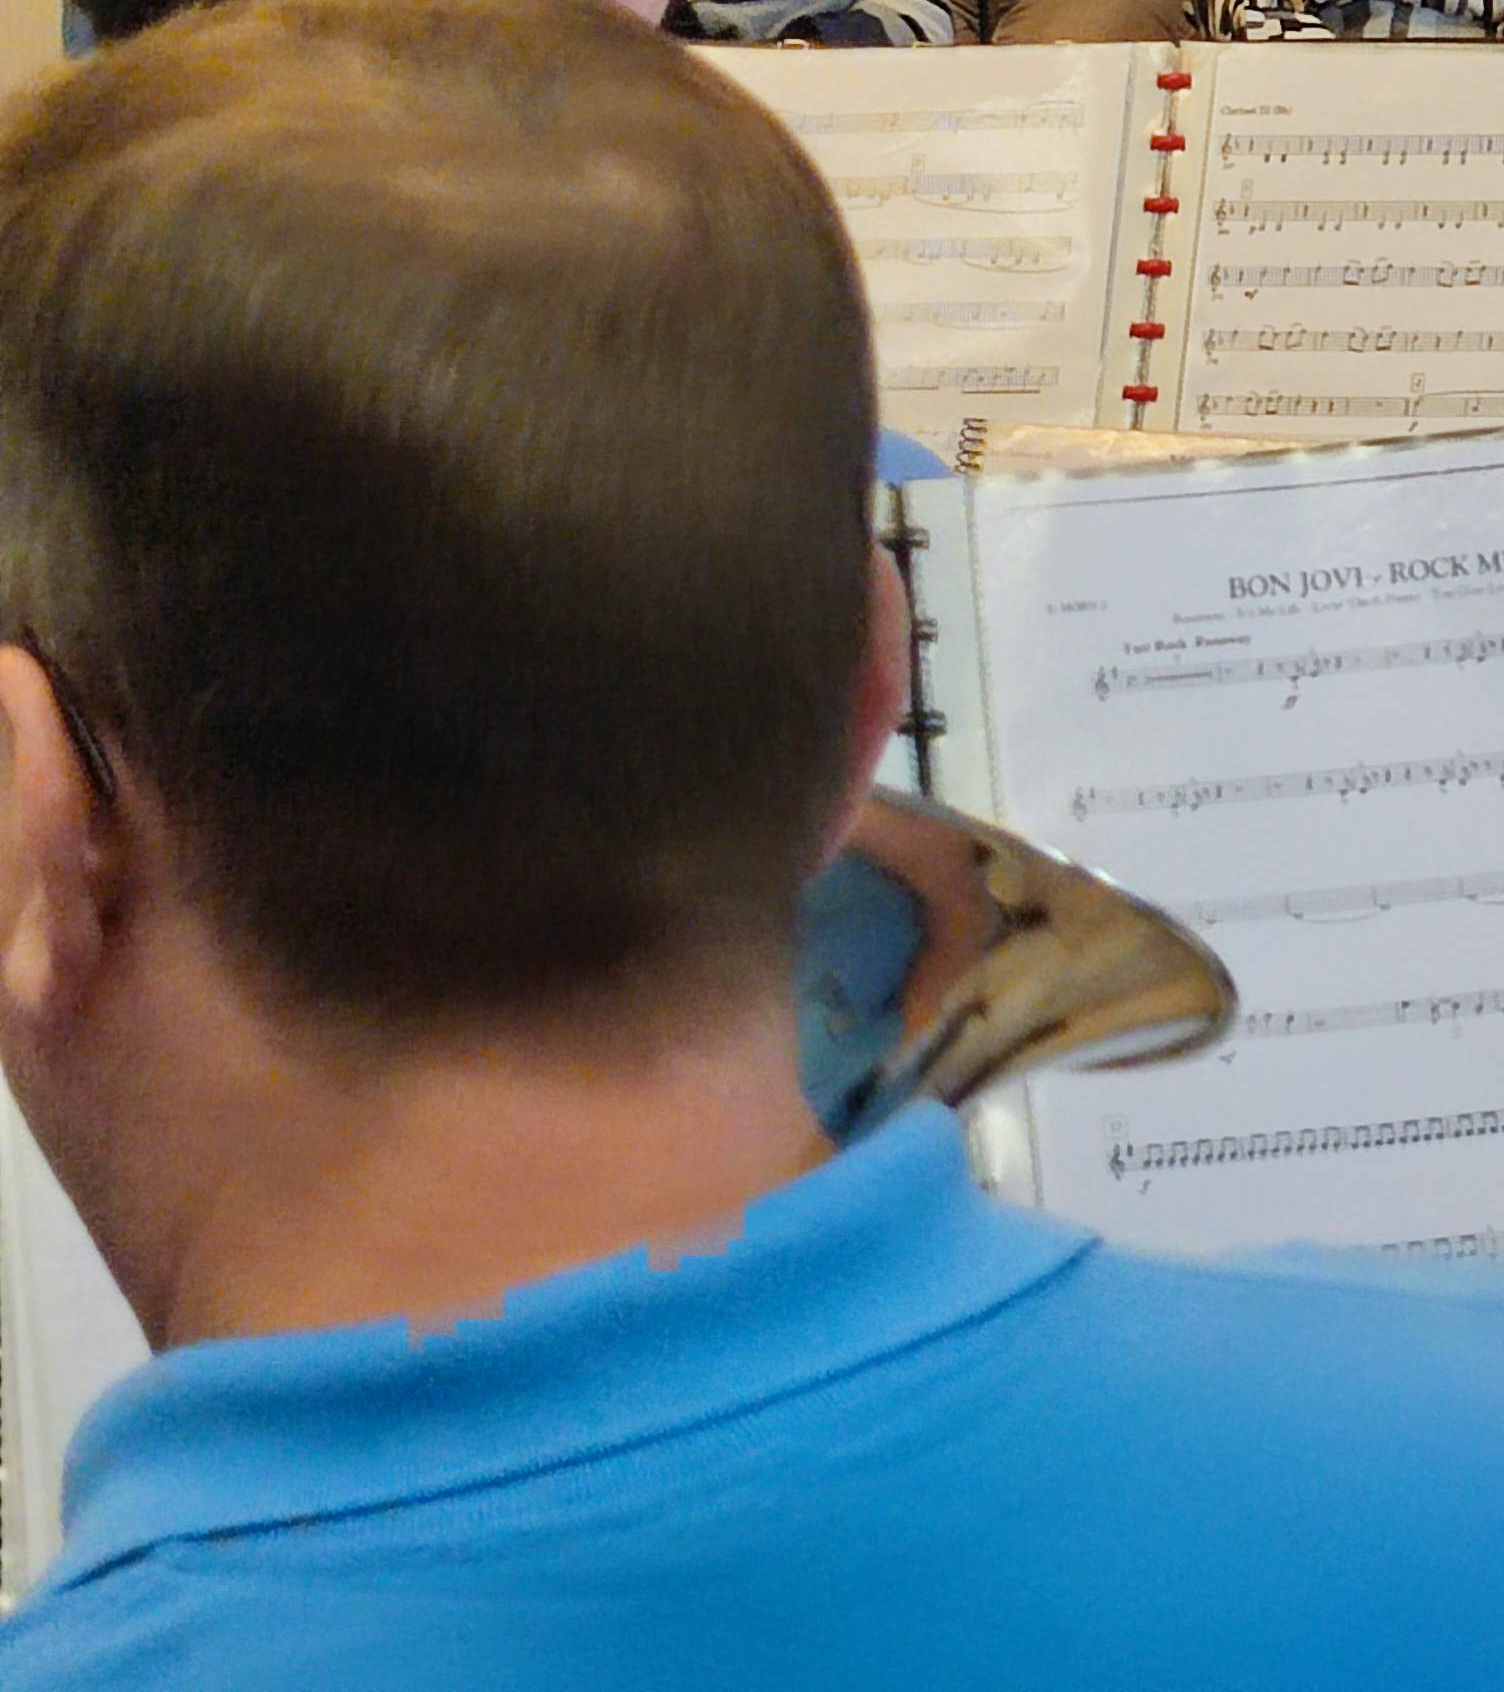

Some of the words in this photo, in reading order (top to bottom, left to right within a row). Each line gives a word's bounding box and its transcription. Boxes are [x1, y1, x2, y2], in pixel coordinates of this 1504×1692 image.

[1229, 572, 1291, 599] BON
[1299, 566, 1363, 598] JOVI
[1389, 554, 1470, 584] ROCK
